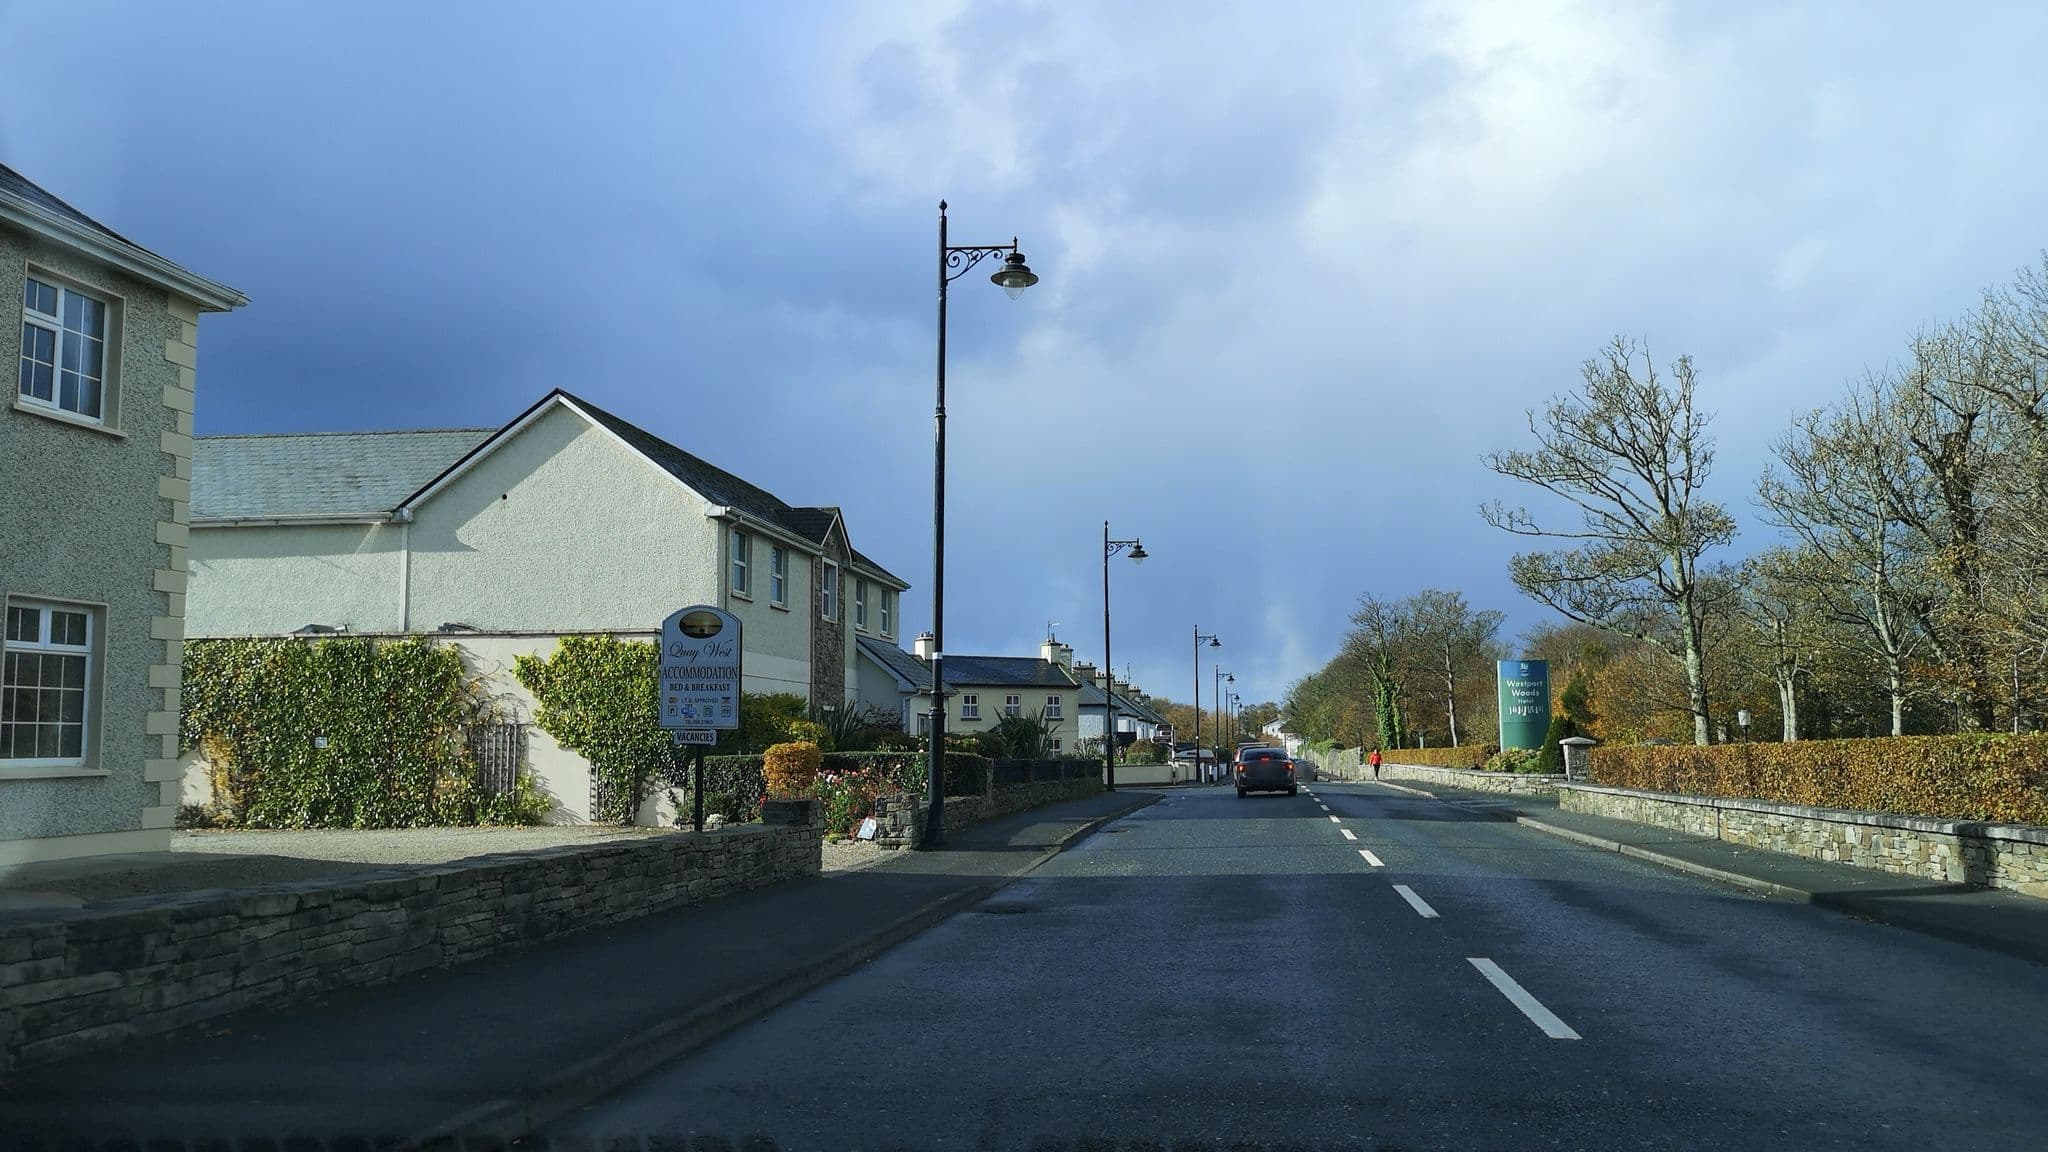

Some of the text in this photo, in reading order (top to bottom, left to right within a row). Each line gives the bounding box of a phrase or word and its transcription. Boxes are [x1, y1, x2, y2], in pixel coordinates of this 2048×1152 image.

[668, 639, 734, 663] Quay West
[662, 666, 738, 679] ACCOMMODATION
[669, 683, 730, 692] BED & BREAKFAST
[1506, 680, 1543, 688] Westport
[1511, 689, 1540, 697] Woods
[677, 732, 714, 742] VACANCIES
